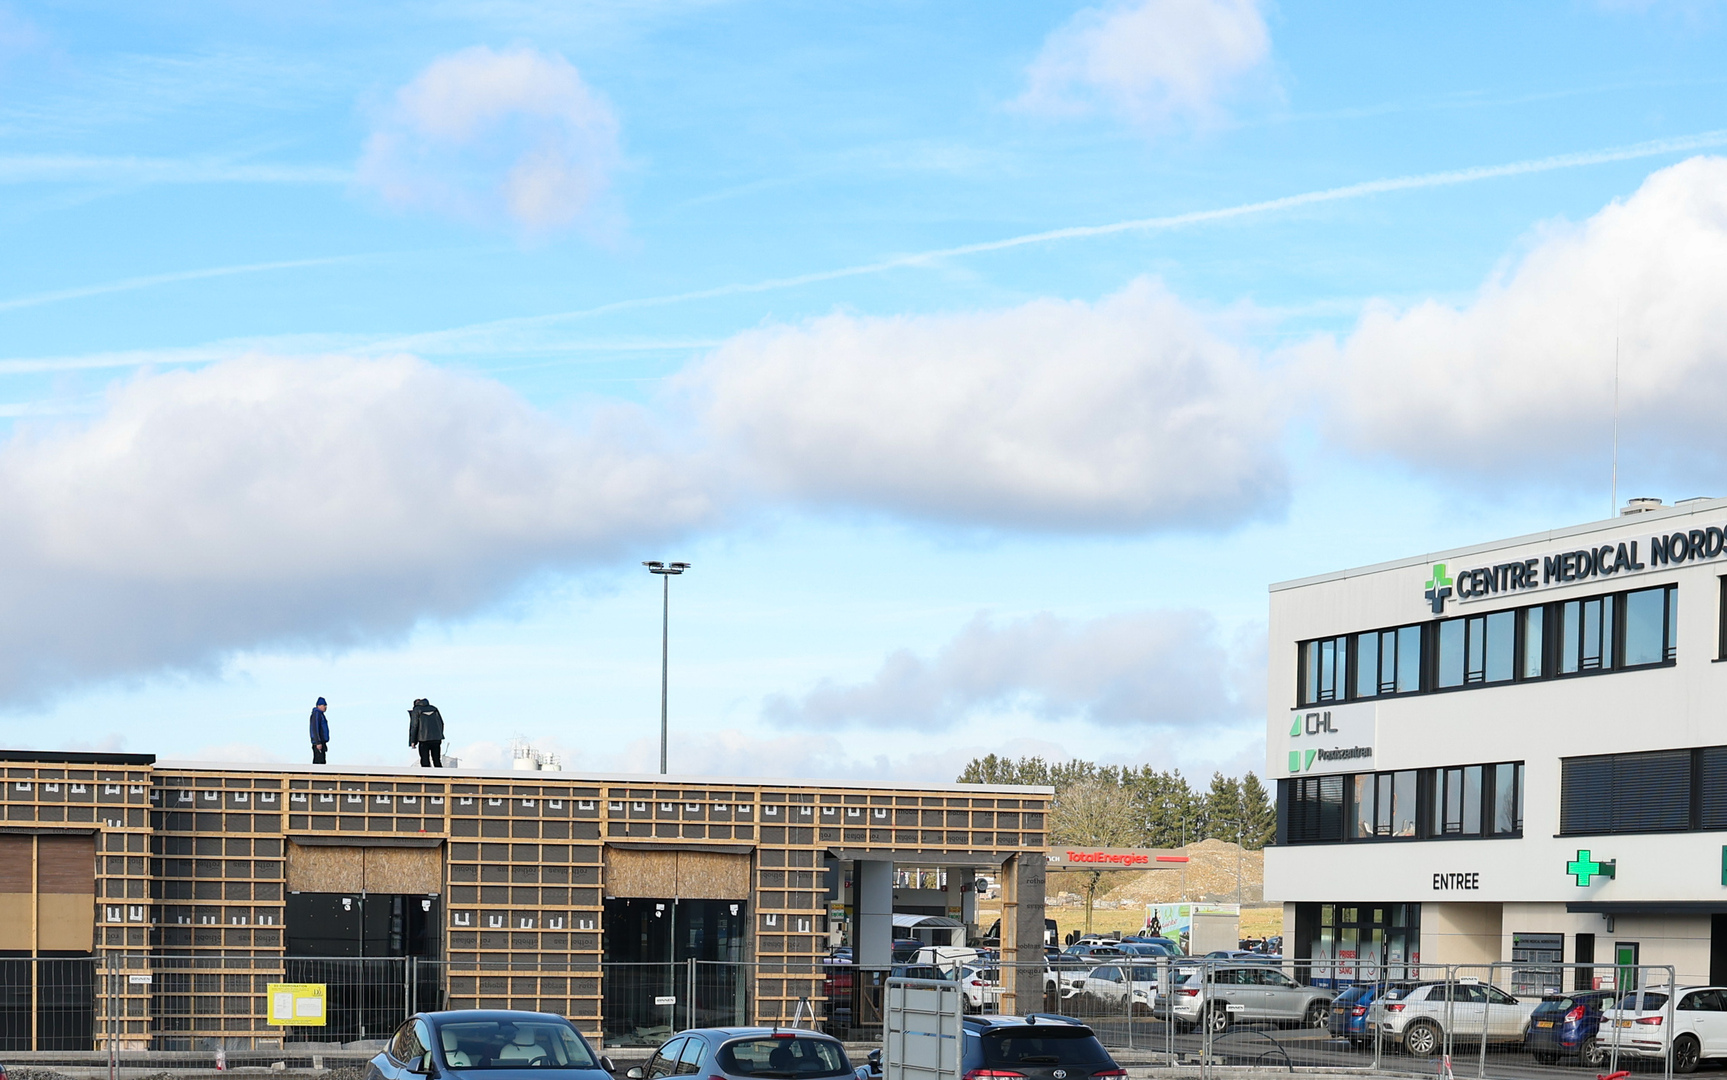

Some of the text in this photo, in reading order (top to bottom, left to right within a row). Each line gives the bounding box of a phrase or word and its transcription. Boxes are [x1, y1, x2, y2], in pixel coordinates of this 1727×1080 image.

[1456, 524, 1727, 598] CENTRE MEDICAL NORD
[1306, 711, 1338, 735] CHL
[1317, 745, 1372, 761] Praxiszentren
[1066, 851, 1149, 866] TotalEnergies
[1433, 872, 1479, 890] ENTREE
[1339, 950, 1356, 959] PRISES
[1339, 967, 1353, 975] SANG
